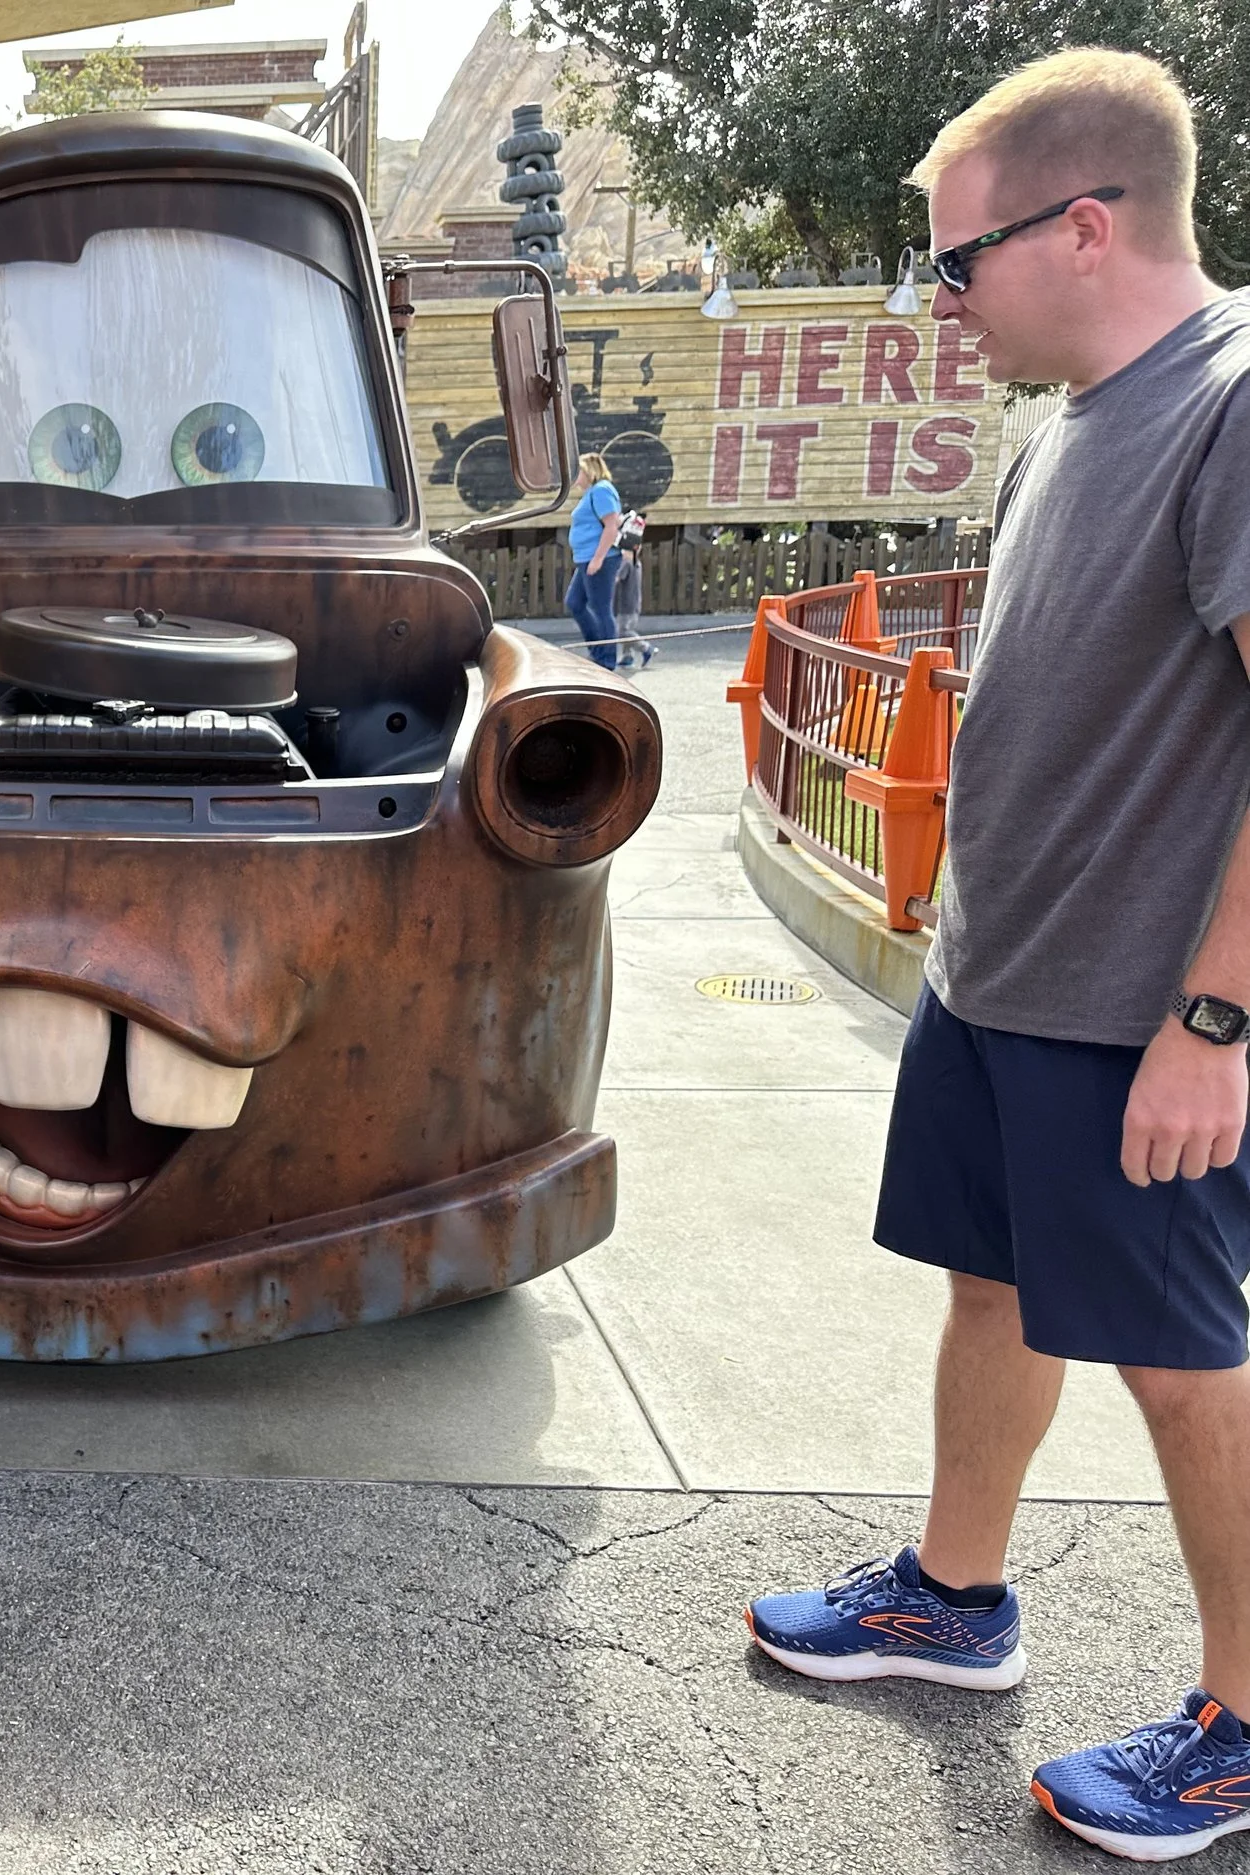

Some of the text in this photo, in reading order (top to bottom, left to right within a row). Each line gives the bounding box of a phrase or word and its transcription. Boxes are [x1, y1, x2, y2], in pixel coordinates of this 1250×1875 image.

[717, 324, 986, 409] HERE
[710, 415, 978, 503] IT IS
